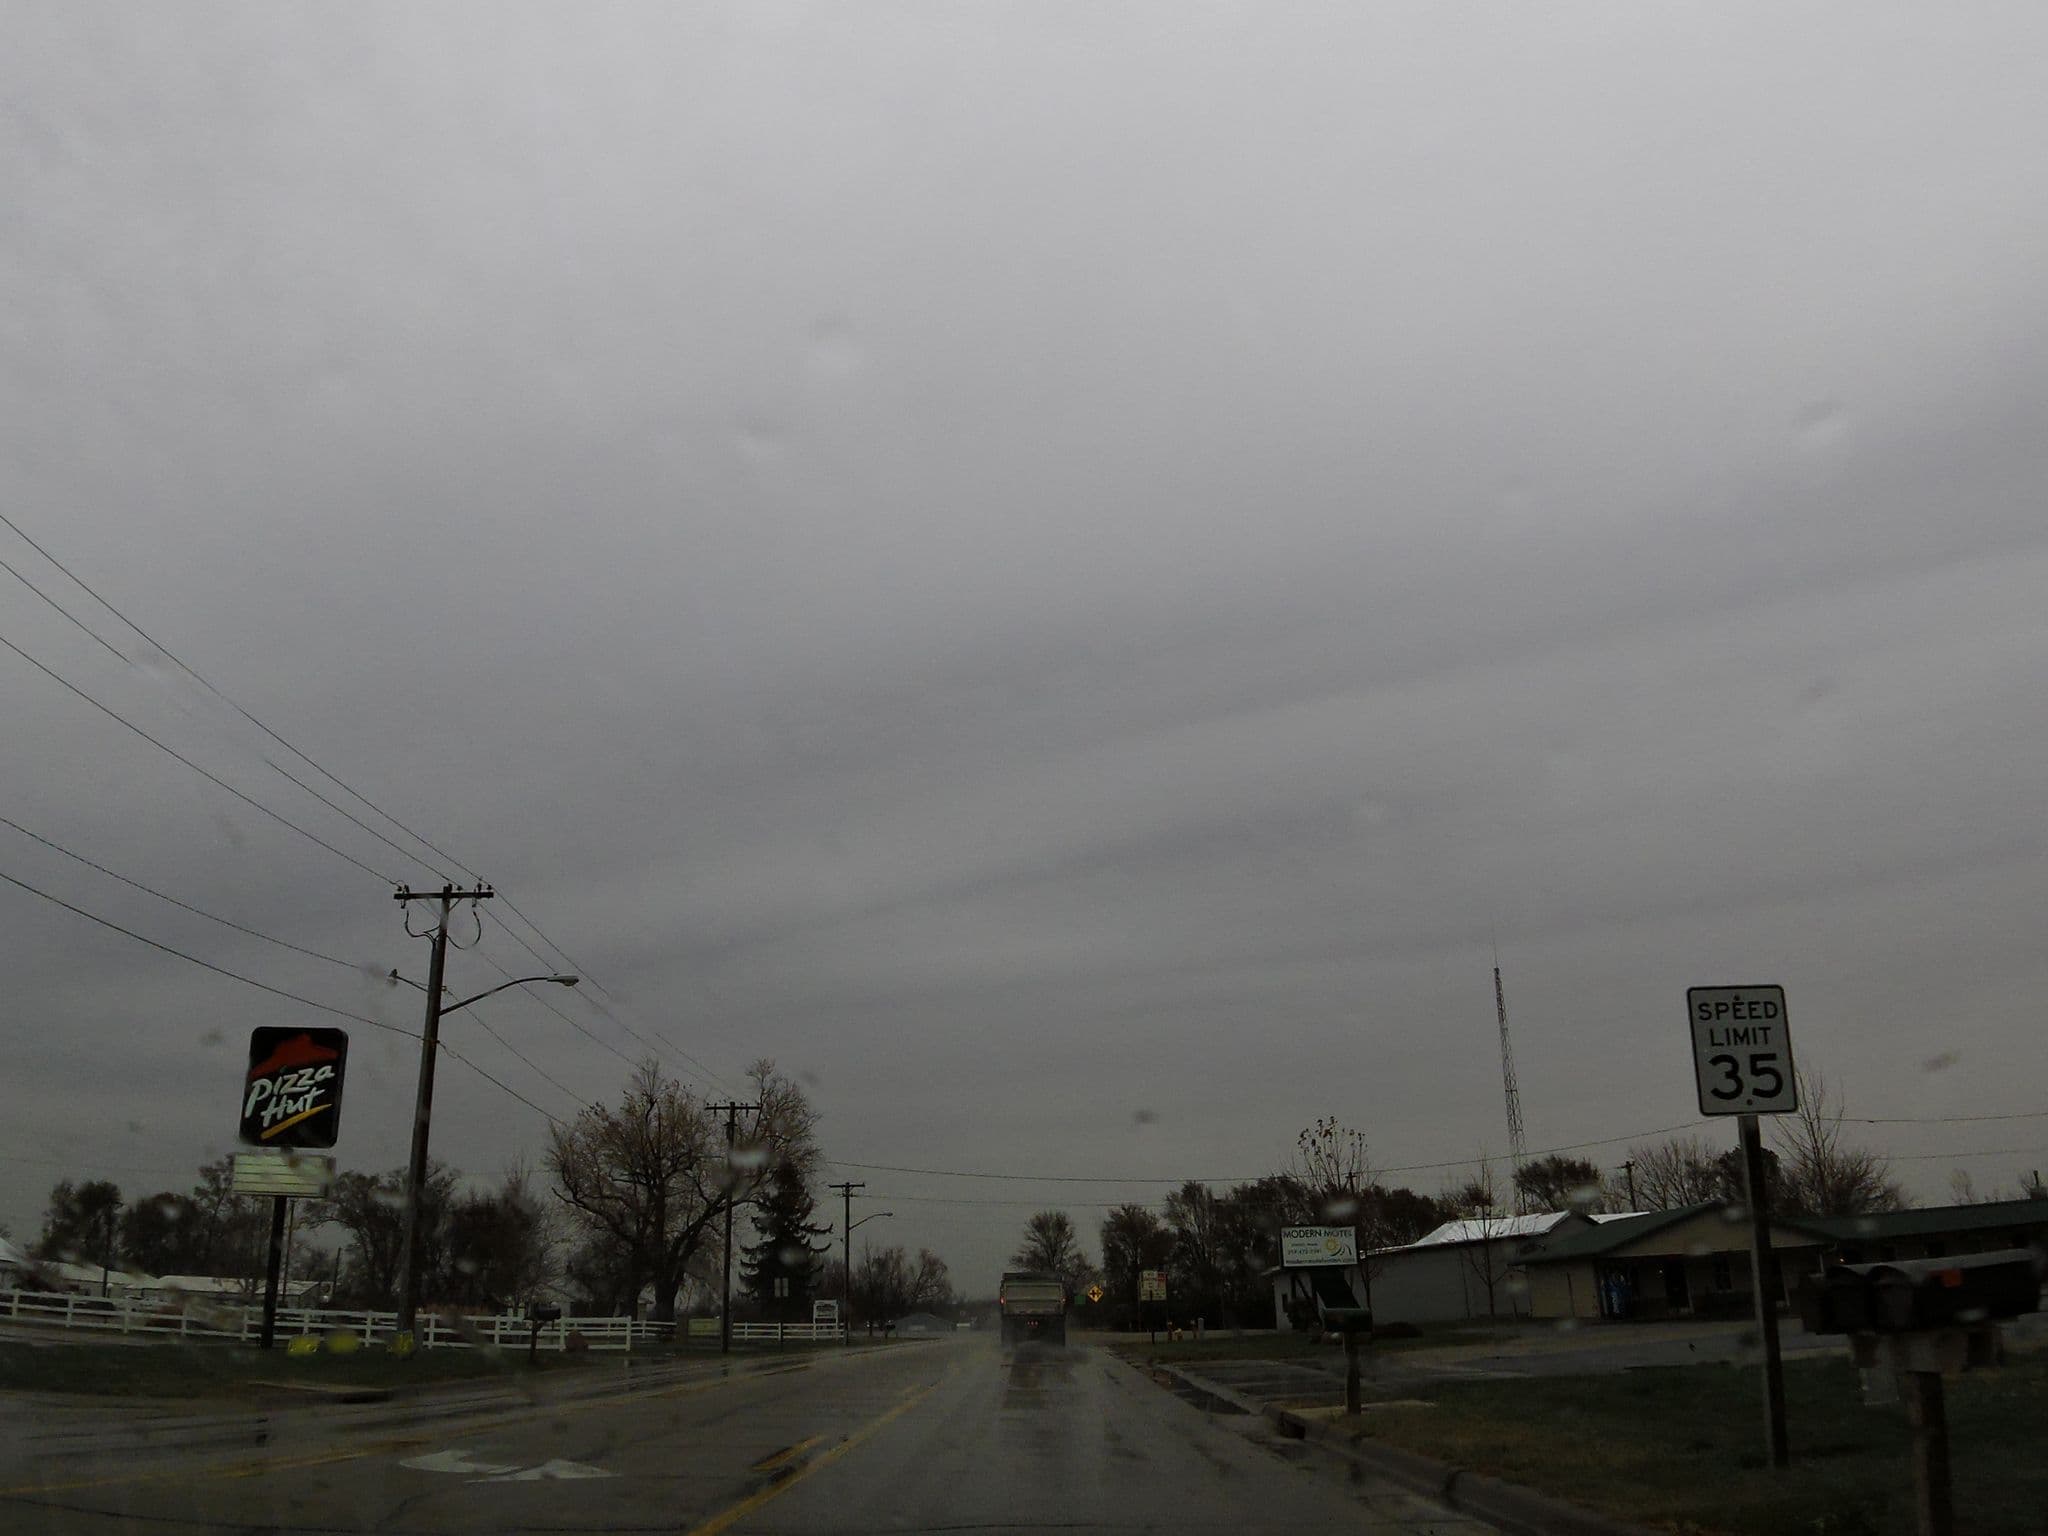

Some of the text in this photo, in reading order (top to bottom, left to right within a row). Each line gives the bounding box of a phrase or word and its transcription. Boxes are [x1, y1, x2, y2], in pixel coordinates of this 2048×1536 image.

[1698, 1001, 1778, 1020] SPEED
[1710, 1027, 1771, 1046] LIMIT
[1709, 1053, 1783, 1100] 35
[244, 1065, 336, 1120] Pizza
[260, 1086, 326, 1128] Hut
[1282, 1229, 1321, 1238] MODERN
